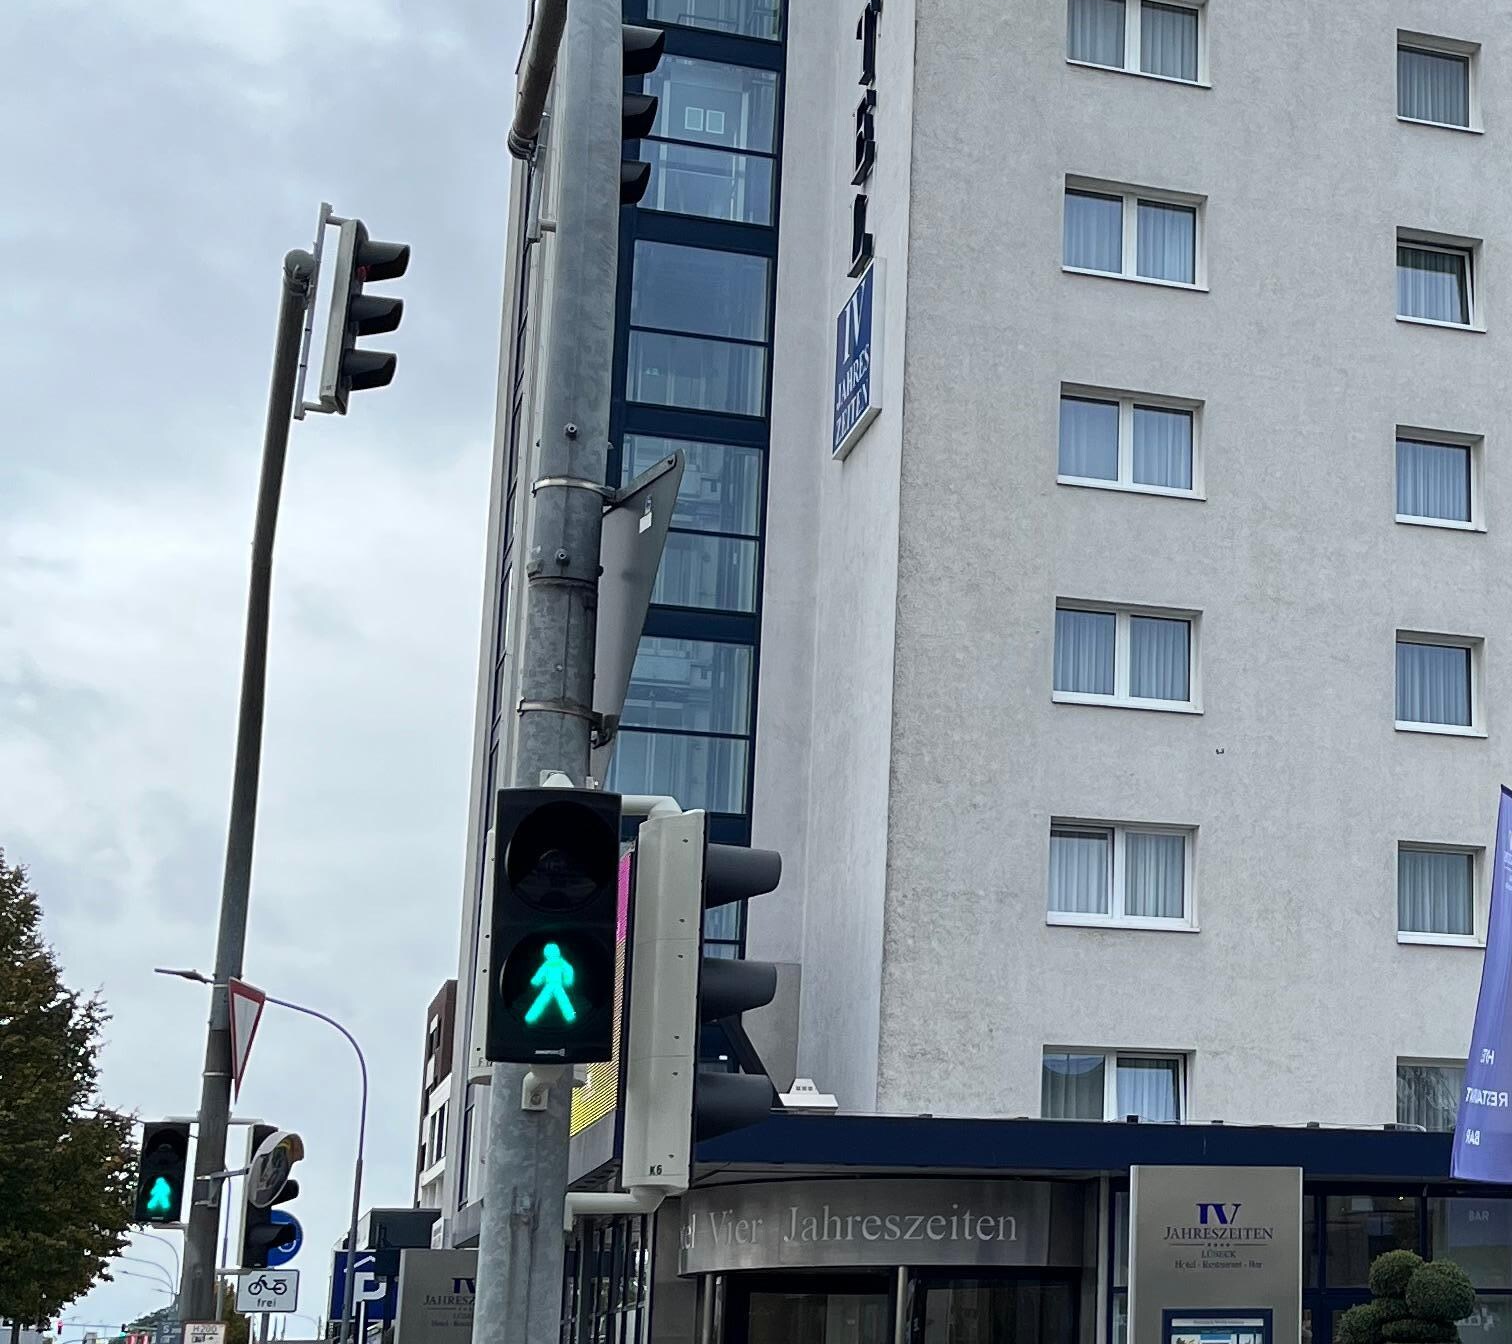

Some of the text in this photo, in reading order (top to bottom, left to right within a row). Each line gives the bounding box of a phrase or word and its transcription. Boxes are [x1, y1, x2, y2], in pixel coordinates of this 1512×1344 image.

[842, 280, 866, 366] IV
[836, 344, 870, 412] JAHRES
[835, 382, 868, 447] ZEITEN
[649, 1164, 663, 1176] K6
[1196, 1203, 1243, 1225] IV
[1468, 1209, 1490, 1222] BAR
[709, 1208, 764, 1247] Vier
[783, 1203, 1017, 1242] Jahreszeiten
[1163, 1226, 1275, 1241] JAHRESZEITEN
[256, 1298, 277, 1308] frei
[423, 1294, 475, 1306] JAHRESZ
